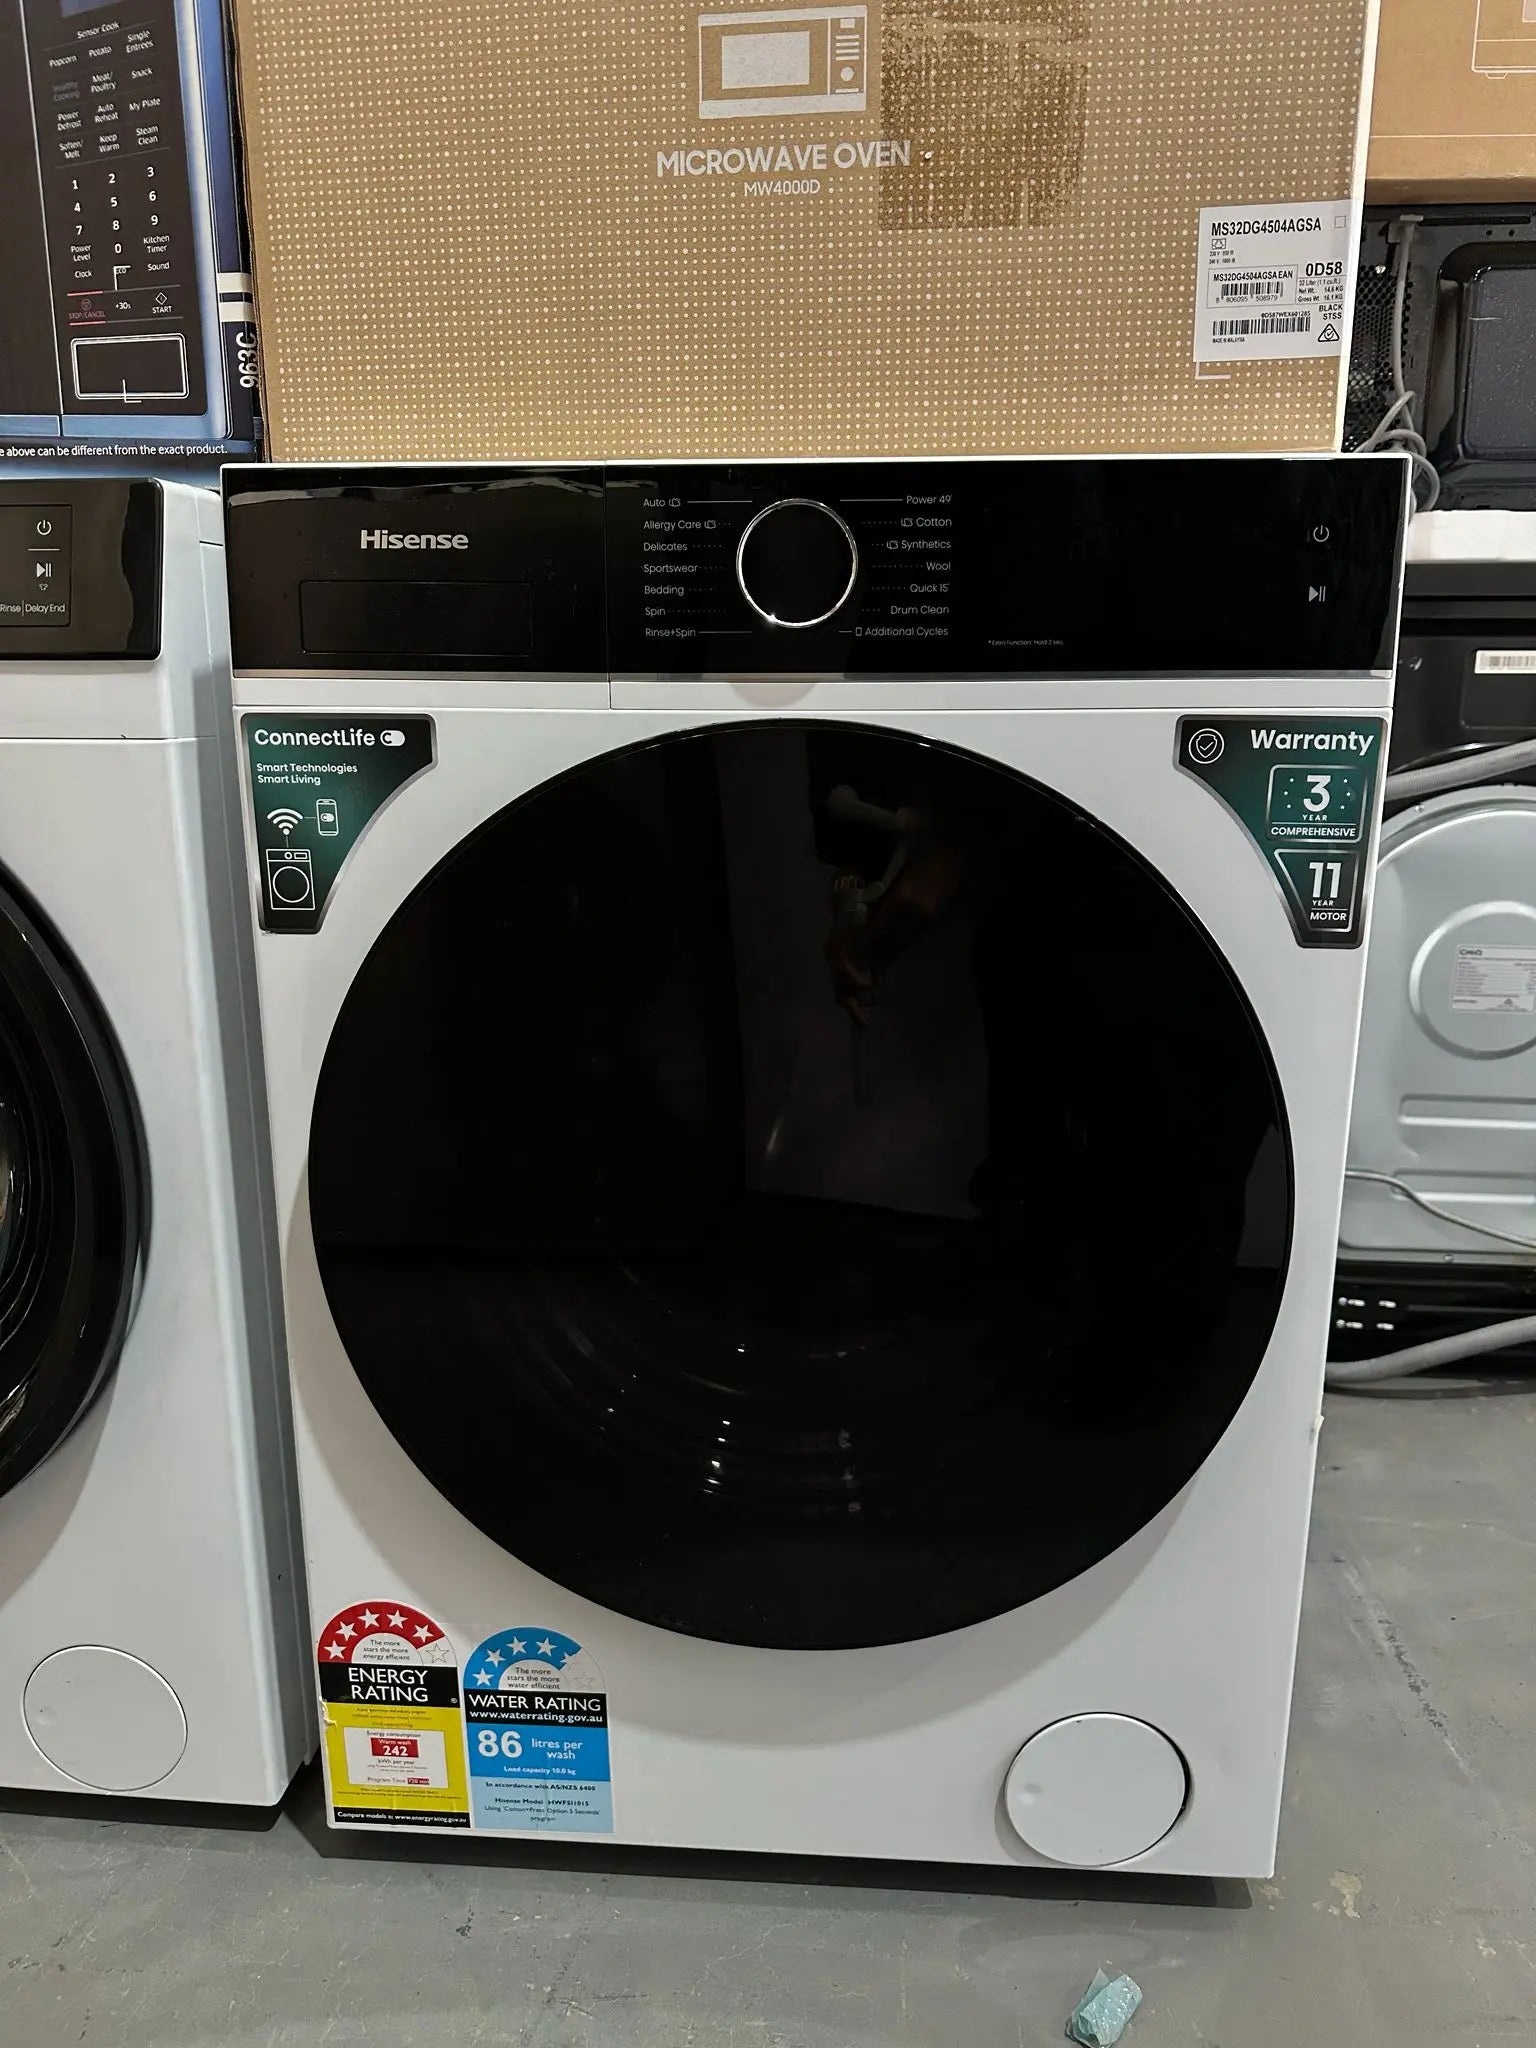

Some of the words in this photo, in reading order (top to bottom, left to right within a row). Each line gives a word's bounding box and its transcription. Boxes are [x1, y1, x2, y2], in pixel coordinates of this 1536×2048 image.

[77, 27, 100, 38] Sensor
[101, 21, 119, 32] Cook
[128, 30, 150, 42] Single
[89, 45, 112, 57] Potato
[49, 54, 78, 68] Popcorn
[131, 67, 153, 79] Snack
[91, 81, 117, 93] Poultry
[98, 103, 115, 112] Auto
[129, 103, 141, 112] My
[142, 98, 161, 108] Plate
[58, 111, 80, 121] Power
[94, 112, 119, 123] Reheat
[57, 120, 82, 131] Defrost
[136, 125, 159, 136] Steam
[100, 133, 118, 144] Keep
[138, 134, 159, 146] Clean
[98, 143, 120, 154] Warm
[64, 151, 80, 160] Melt
[834, 140, 911, 169] OVEN
[656, 144, 827, 177] MICROWAVE
[147, 166, 154, 178] 3
[108, 173, 116, 184] 2
[72, 180, 78, 190] 1
[744, 179, 820, 197] MW4000D
[111, 196, 118, 207] 5
[149, 190, 156, 202] 6
[74, 202, 81, 212] 4
[112, 220, 120, 230] 8
[151, 214, 158, 226] 9
[76, 225, 82, 236] 7
[1212, 218, 1322, 236] MS32DG4504AGSA
[143, 234, 170, 245] Kitchen
[70, 244, 92, 254] Power
[114, 243, 122, 254] 0
[146, 244, 168, 254] Timer
[73, 253, 90, 262] Level
[147, 262, 170, 272] Sound
[1306, 262, 1342, 277] 0D58
[74, 270, 92, 279] Clock
[1214, 272, 1278, 282] MS32DG4504AGSA
[1278, 270, 1294, 279] EAN
[152, 306, 173, 314] START
[1318, 304, 1343, 312] BLACK
[1322, 312, 1342, 320] STSS
[236, 331, 258, 389] 963C
[6, 446, 36, 456] above
[38, 448, 55, 456] can
[57, 446, 70, 456] be
[71, 445, 114, 456] different
[114, 444, 138, 456] from
[140, 444, 156, 455] the
[158, 445, 185, 455] exact
[186, 444, 228, 456] product.
[644, 498, 666, 507] Auto
[906, 495, 938, 505] Power
[644, 520, 676, 532] Allergy
[678, 520, 702, 529] Care
[916, 517, 952, 528] Cotton
[361, 530, 468, 549] Hisense
[644, 542, 688, 551] Delicates
[901, 540, 952, 551] Synthetics
[644, 564, 698, 574] Sportswear
[926, 562, 950, 571] Wool
[644, 585, 684, 596] Bedding
[910, 583, 938, 592] Quick
[0, 604, 21, 612] Rinse
[25, 604, 49, 614] Delay
[50, 604, 66, 612] End
[645, 606, 666, 618] Spin
[890, 605, 918, 614] Drum
[920, 605, 950, 614] Clean
[646, 628, 696, 639] Rinse+Spin
[865, 626, 914, 636] Additional
[916, 626, 948, 638] Cycles
[254, 728, 376, 746] ConnectLife
[1250, 729, 1374, 756] Warranty
[257, 763, 288, 772] Smart
[289, 763, 358, 774] Technologies
[258, 775, 290, 784] Smart
[291, 775, 320, 786] Living
[1303, 774, 1332, 812] 3
[1271, 826, 1356, 837] COMPREHENSIVE
[1309, 862, 1342, 898] 11
[1310, 912, 1347, 921] MOTOR
[348, 1667, 428, 1685] ENERGY
[530, 1682, 560, 1690] efficient
[351, 1685, 428, 1702] RATING
[468, 1694, 528, 1709] WATER
[534, 1697, 601, 1712] RATING
[470, 1711, 603, 1724] www.waterrating.gov.au
[478, 1730, 522, 1758] 86
[532, 1738, 560, 1748] litres
[564, 1740, 583, 1750] per
[382, 1746, 408, 1756] 242
[546, 1750, 576, 1760] wash
[522, 1767, 551, 1775] capacity
[338, 1811, 364, 1819] Compare
[395, 1815, 467, 1823] www.energyrating.gov.au
